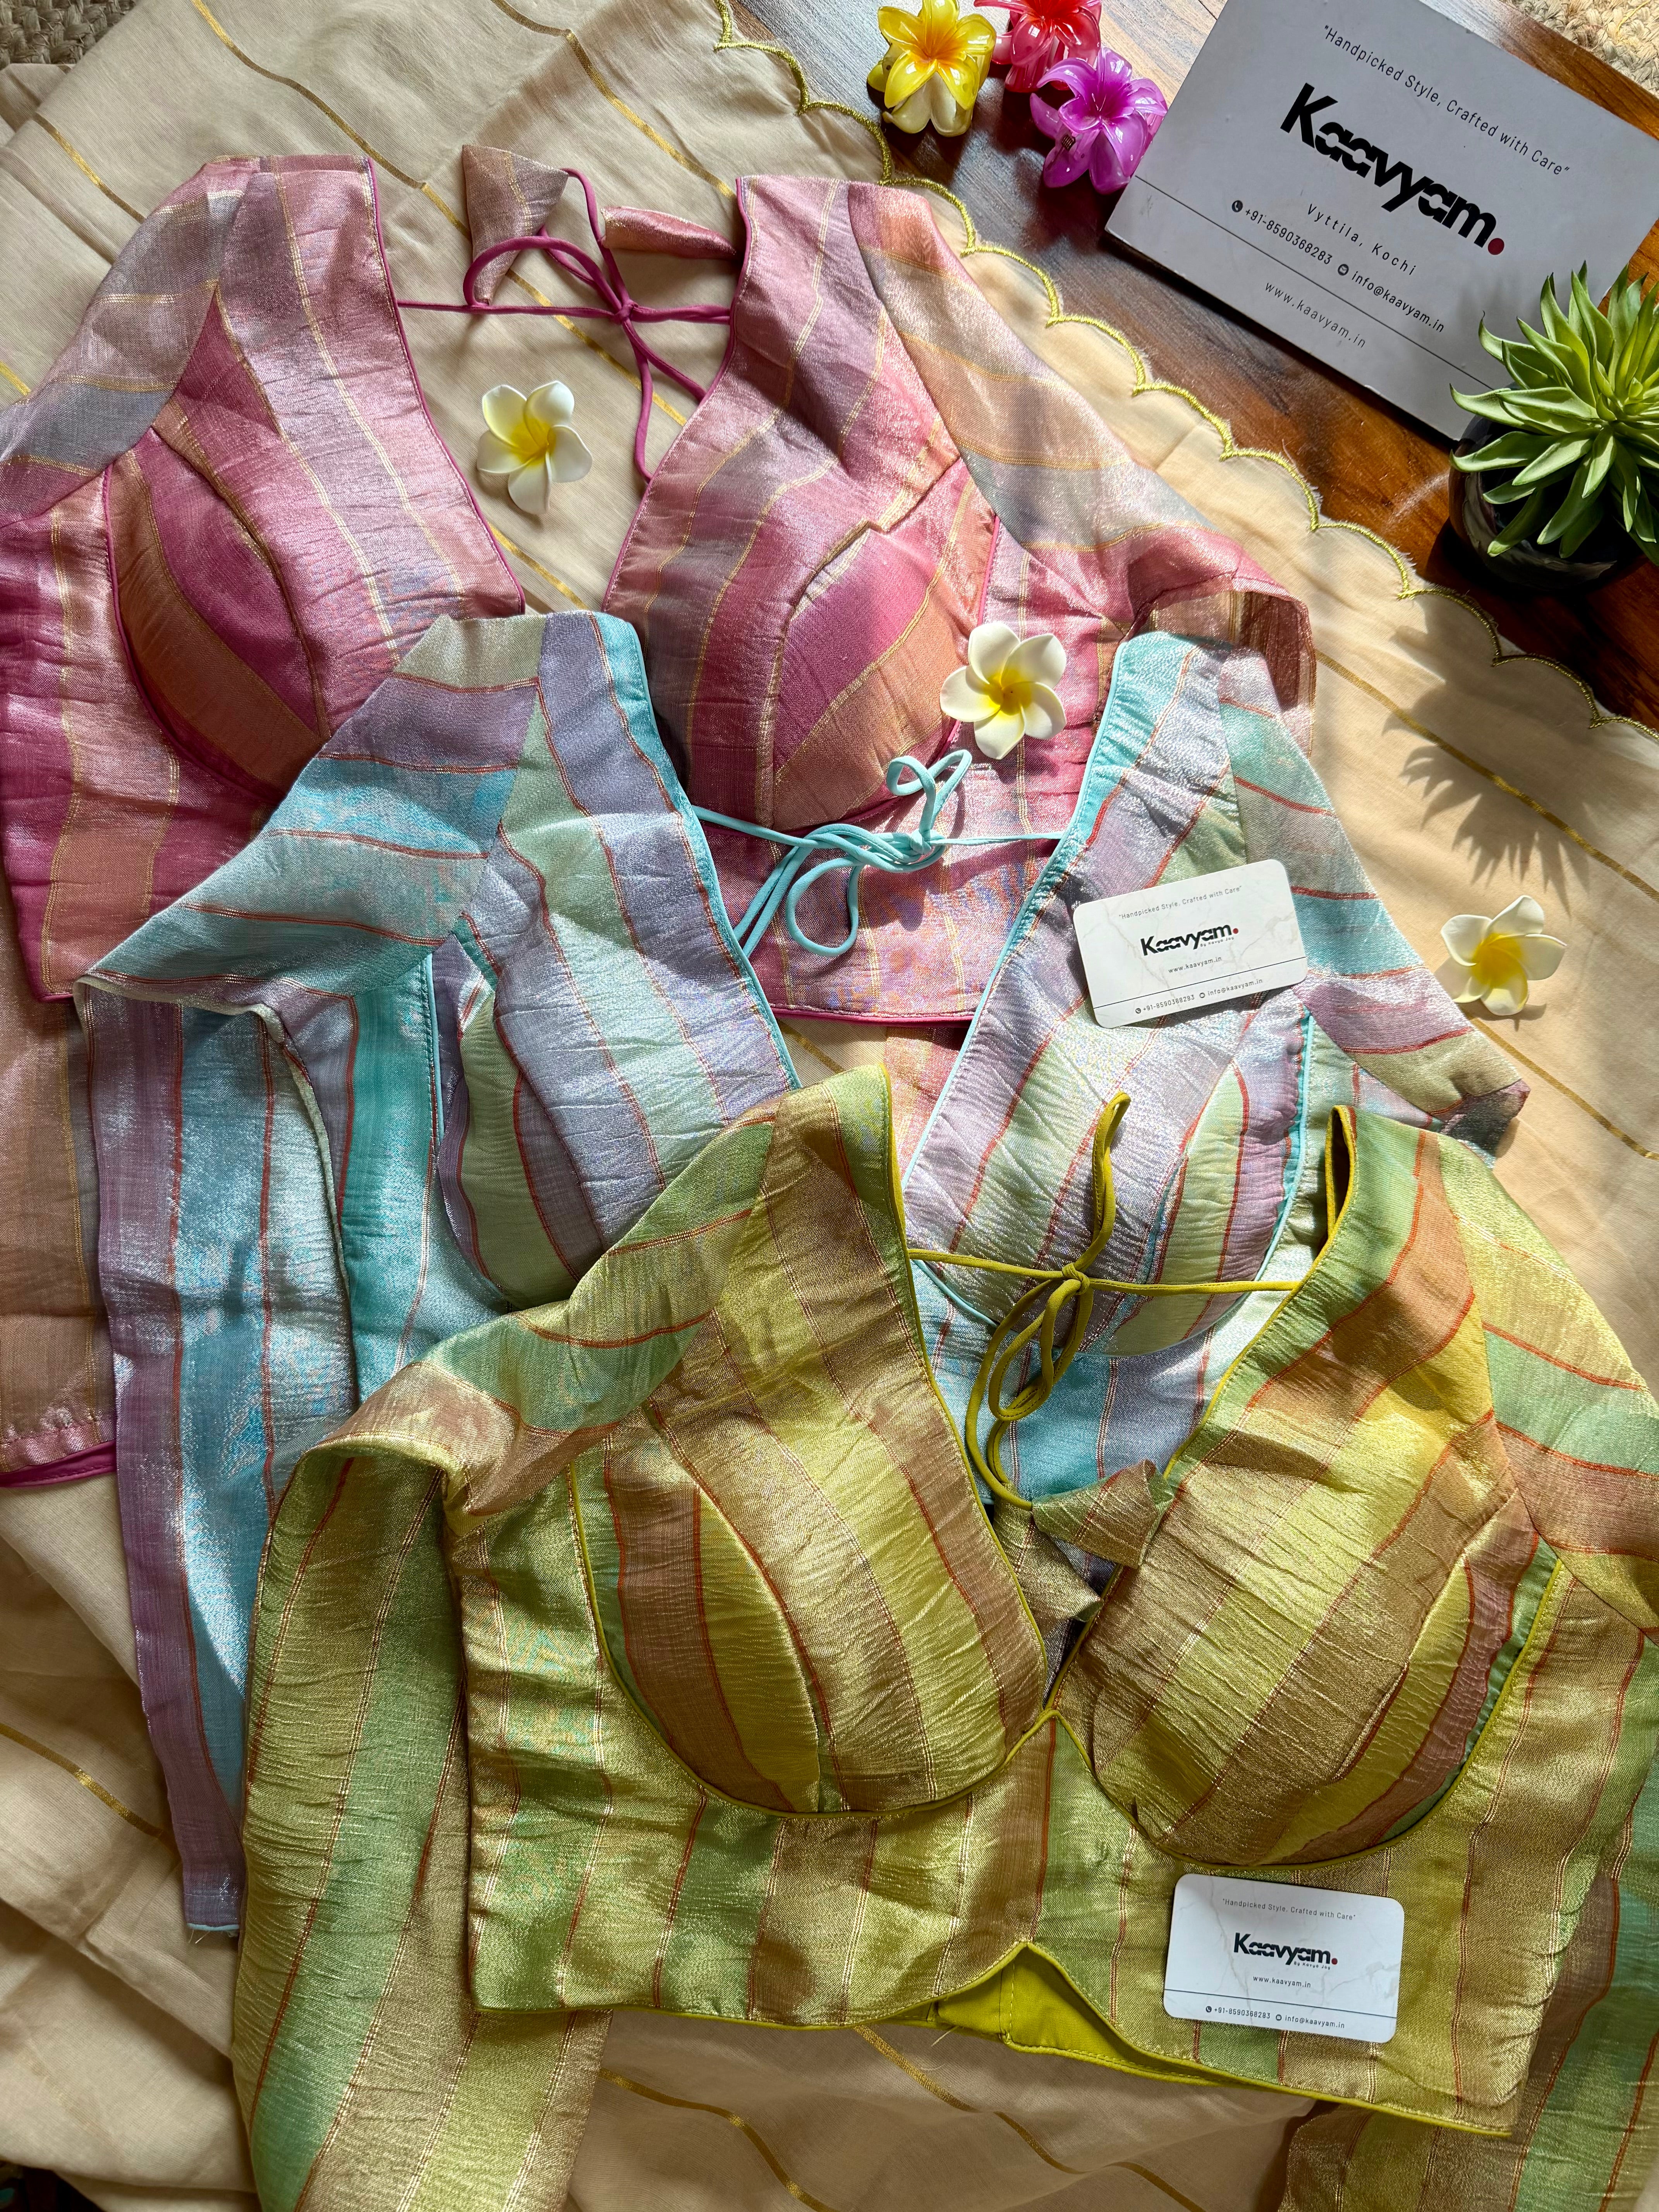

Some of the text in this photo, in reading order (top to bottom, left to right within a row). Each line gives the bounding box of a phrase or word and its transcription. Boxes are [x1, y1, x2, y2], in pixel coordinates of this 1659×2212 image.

[1324, 25, 1404, 81] "Handpicked
[1405, 75, 1441, 106] Style,
[1447, 100, 1499, 137] Crafted
[1500, 132, 1528, 156] with
[1308, 203, 1416, 275] Vyttila, Kochi
[1245, 209, 1444, 333] +91-8590368283 info@kaavyam.in
[1265, 282, 1365, 348] www.kaavyam.in
[1182, 894, 1207, 905] Crafted
[1168, 957, 1222, 973] www.kaavyam.in
[1143, 979, 1262, 1011] +91-8590368283 info@kaavyam.in
[1291, 1906, 1317, 1916] Crafted
[1253, 1976, 1311, 1988] www.kaavyam.in
[1214, 2007, 1345, 2028] +91-8590368283 info@kaavyam.in
